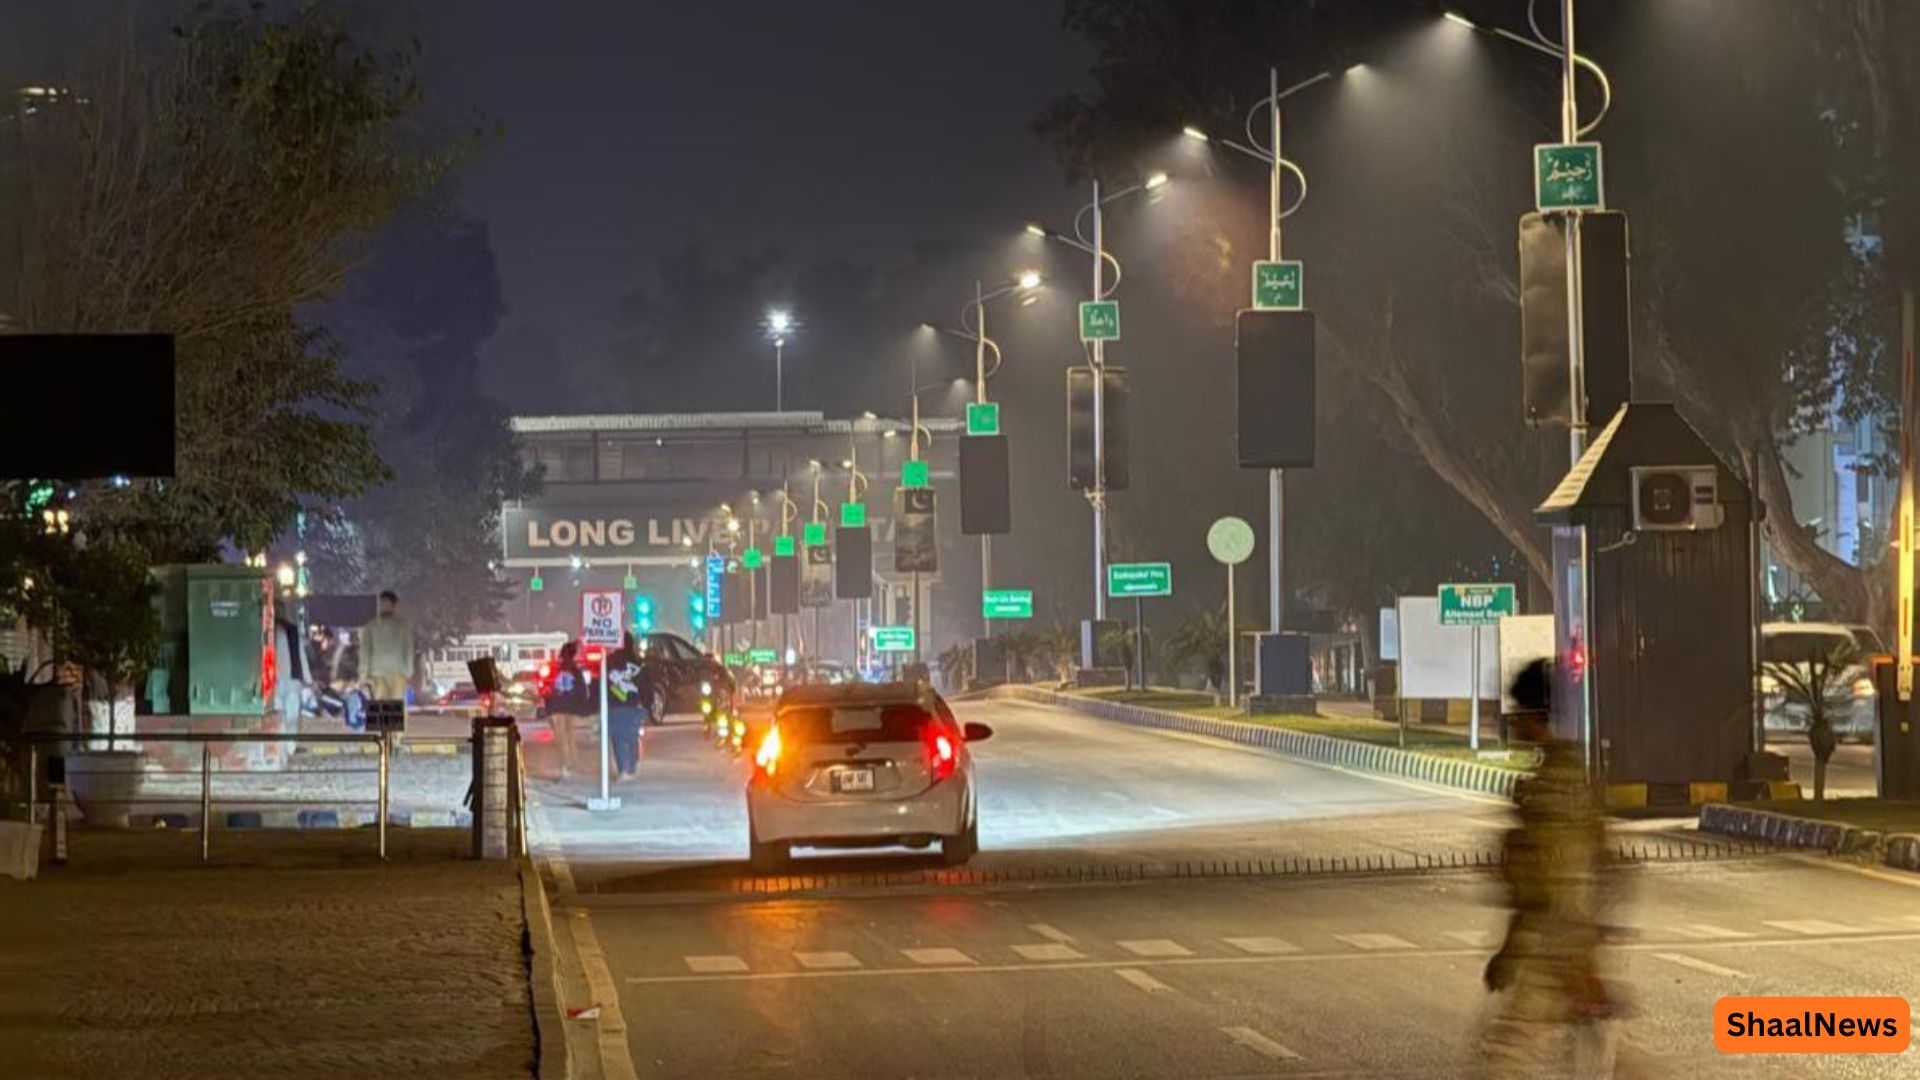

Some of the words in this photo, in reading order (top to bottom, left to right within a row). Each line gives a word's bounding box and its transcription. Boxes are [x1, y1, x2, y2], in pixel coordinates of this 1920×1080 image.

[527, 518, 635, 548] LONG
[1461, 594, 1493, 608] NBP
[592, 617, 612, 627] NO
[585, 627, 620, 637] PARKING
